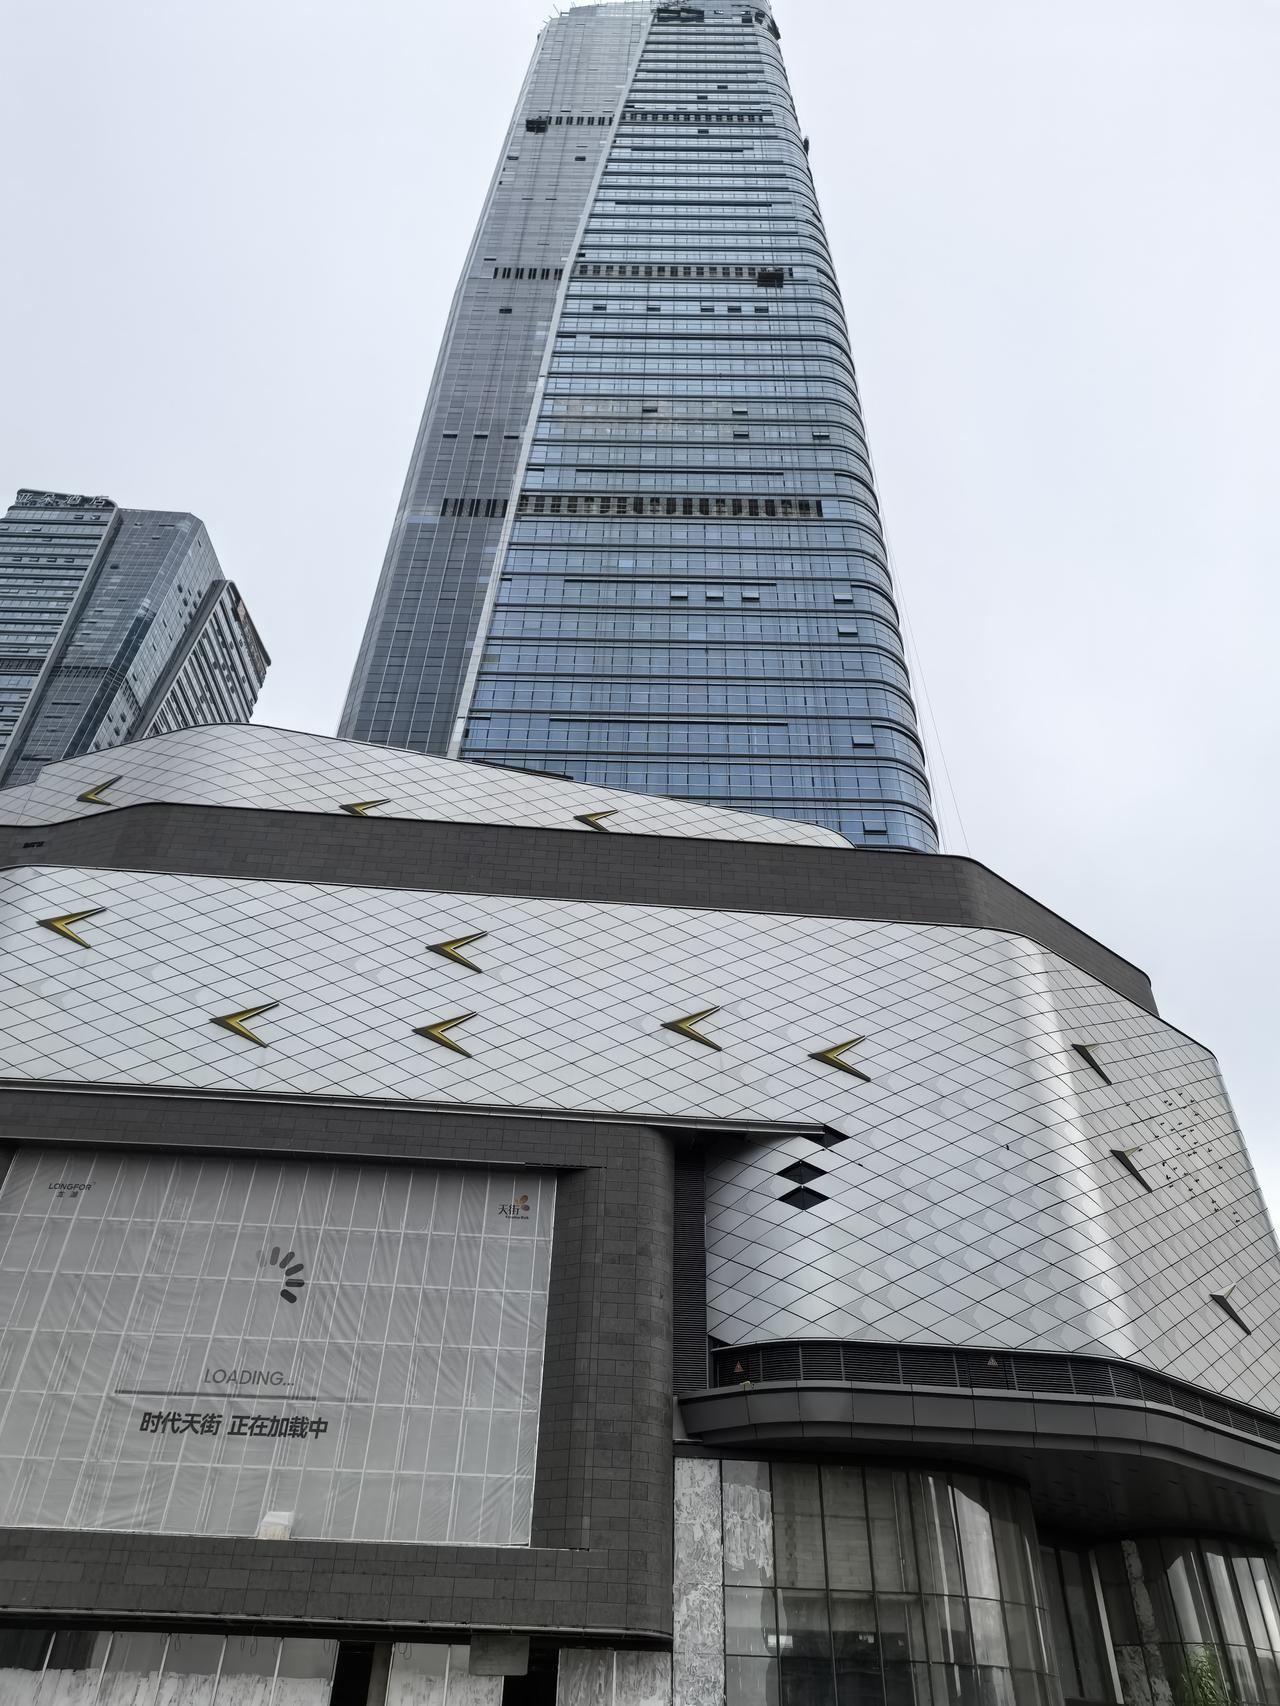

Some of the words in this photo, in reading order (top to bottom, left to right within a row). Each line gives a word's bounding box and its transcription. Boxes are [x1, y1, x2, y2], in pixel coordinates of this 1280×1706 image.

[48, 1182, 92, 1191] LONGFOR
[498, 1204, 520, 1215] 天街
[203, 1368, 295, 1387] LOADING...
[139, 1411, 223, 1435] 时代天街
[227, 1415, 328, 1439] 正在加载中
